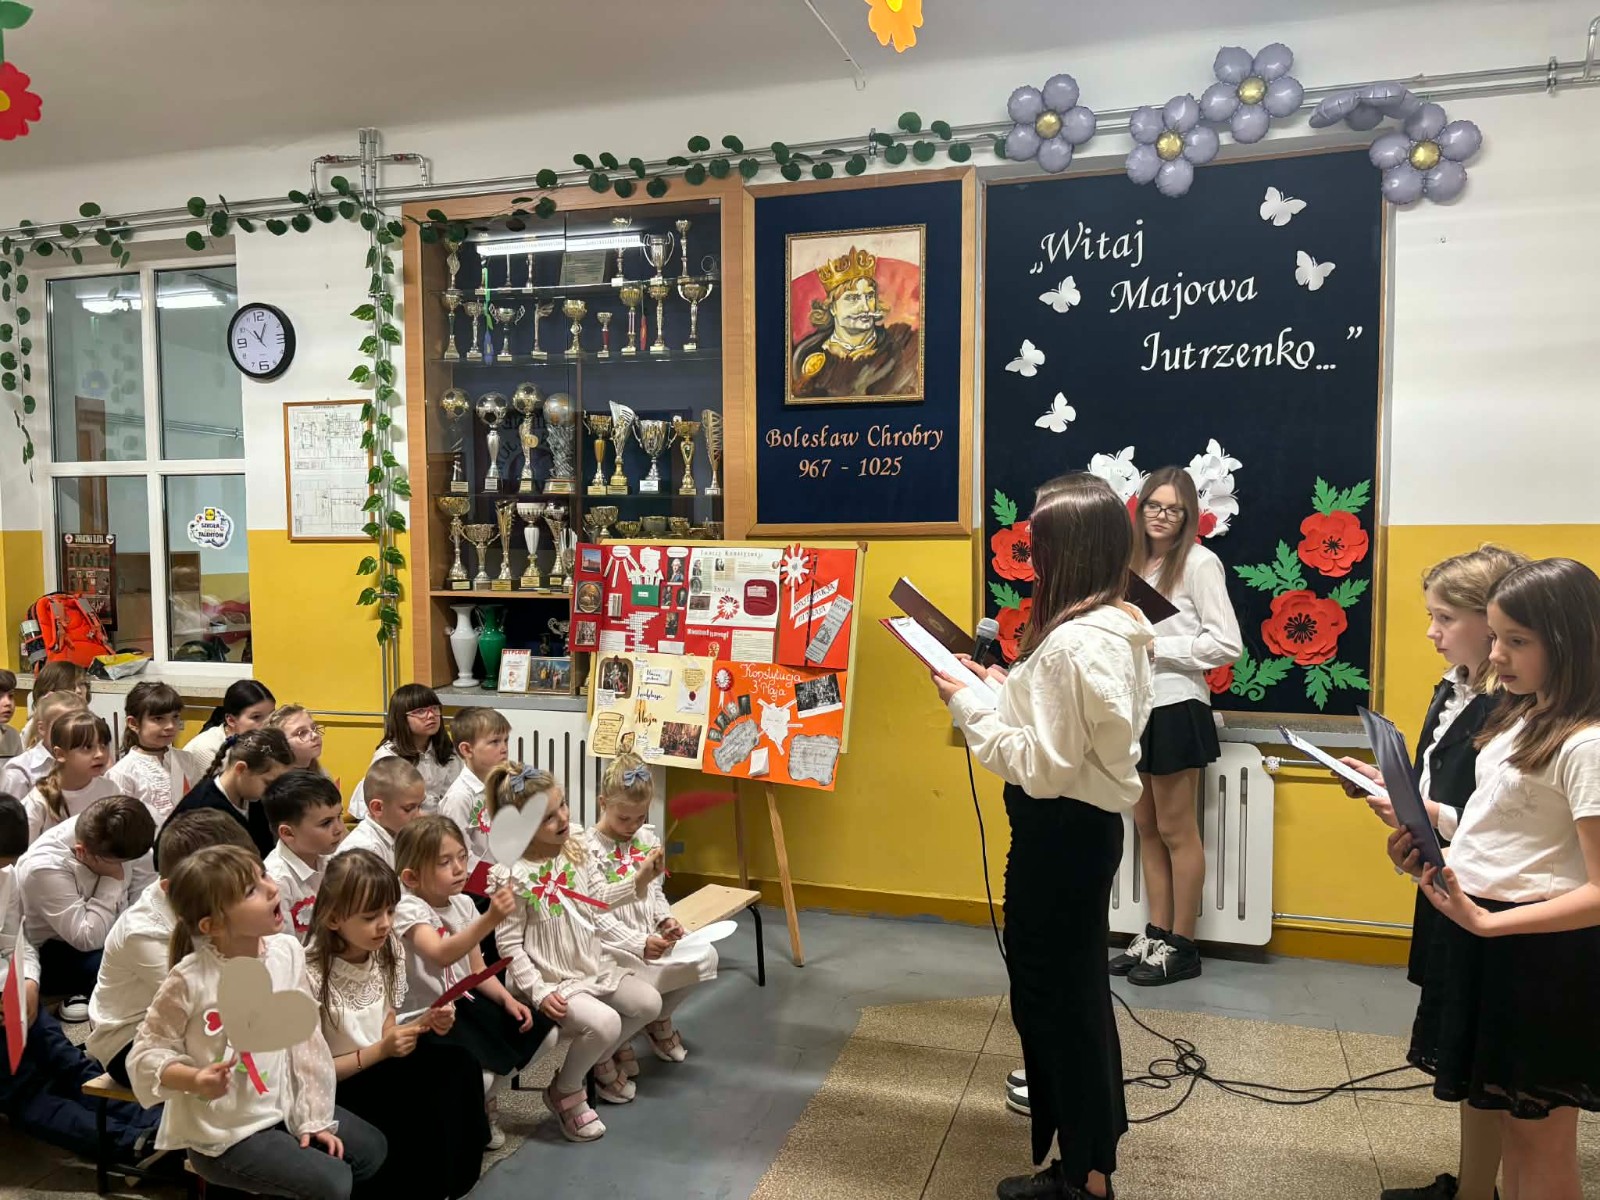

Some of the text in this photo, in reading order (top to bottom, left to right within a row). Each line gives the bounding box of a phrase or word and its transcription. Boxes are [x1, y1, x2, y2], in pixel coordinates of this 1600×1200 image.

[1108, 271, 1258, 320] Majowa
[253, 311, 265, 322] 12
[237, 338, 248, 349] 9
[258, 360, 270, 371] 6
[765, 423, 944, 451] Bolesław Chrobry
[798, 458, 832, 479] 967
[857, 455, 904, 477] 1025
[740, 663, 804, 688] Konstytucja
[749, 680, 787, 702] 3 Maja
